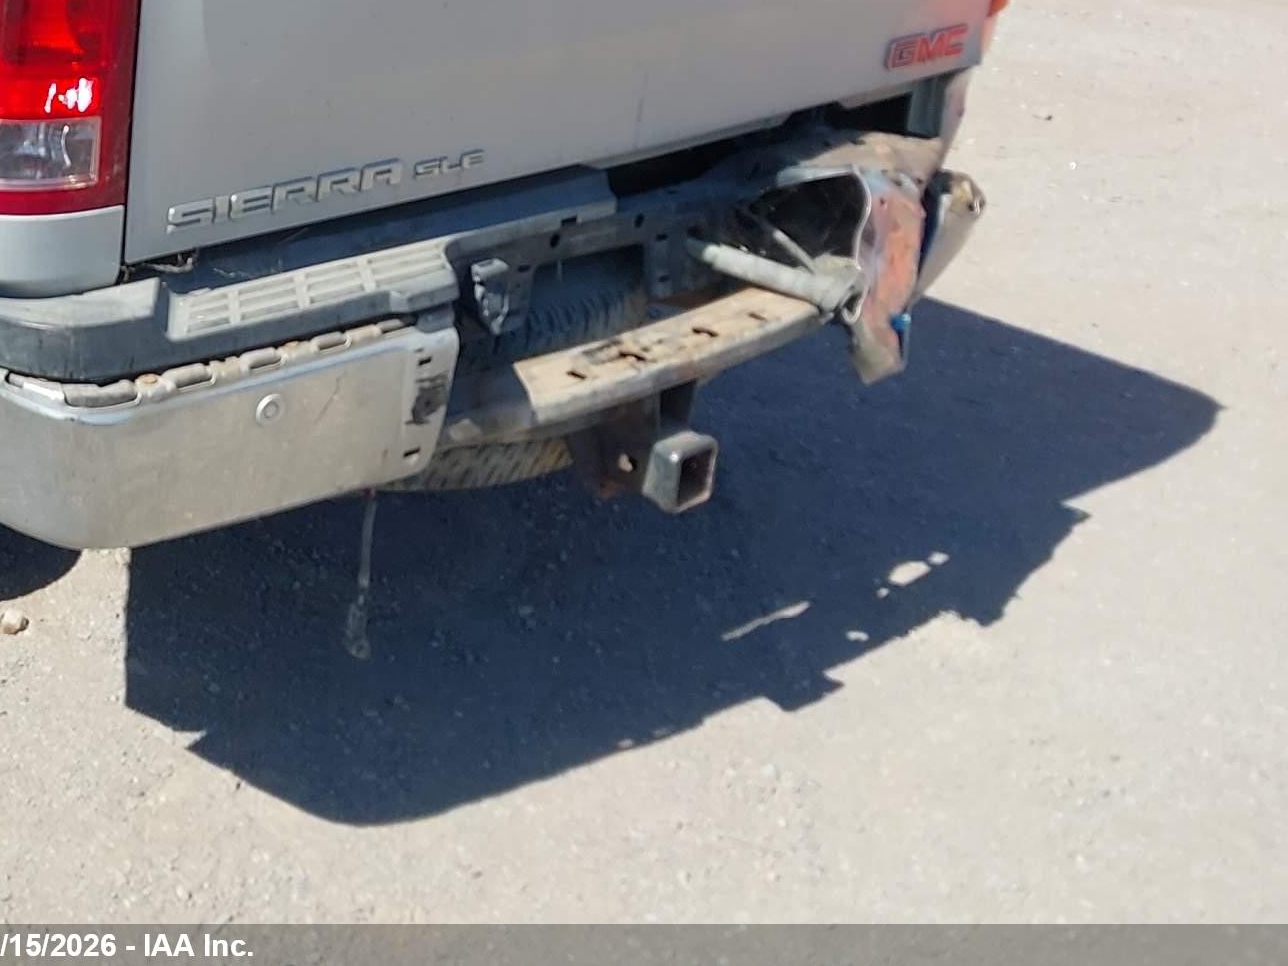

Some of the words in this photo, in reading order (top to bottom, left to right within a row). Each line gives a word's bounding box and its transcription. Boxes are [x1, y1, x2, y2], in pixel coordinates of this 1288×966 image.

[885, 24, 968, 70] GMC
[165, 158, 402, 233] SIERRA
[413, 148, 487, 180] SLE
